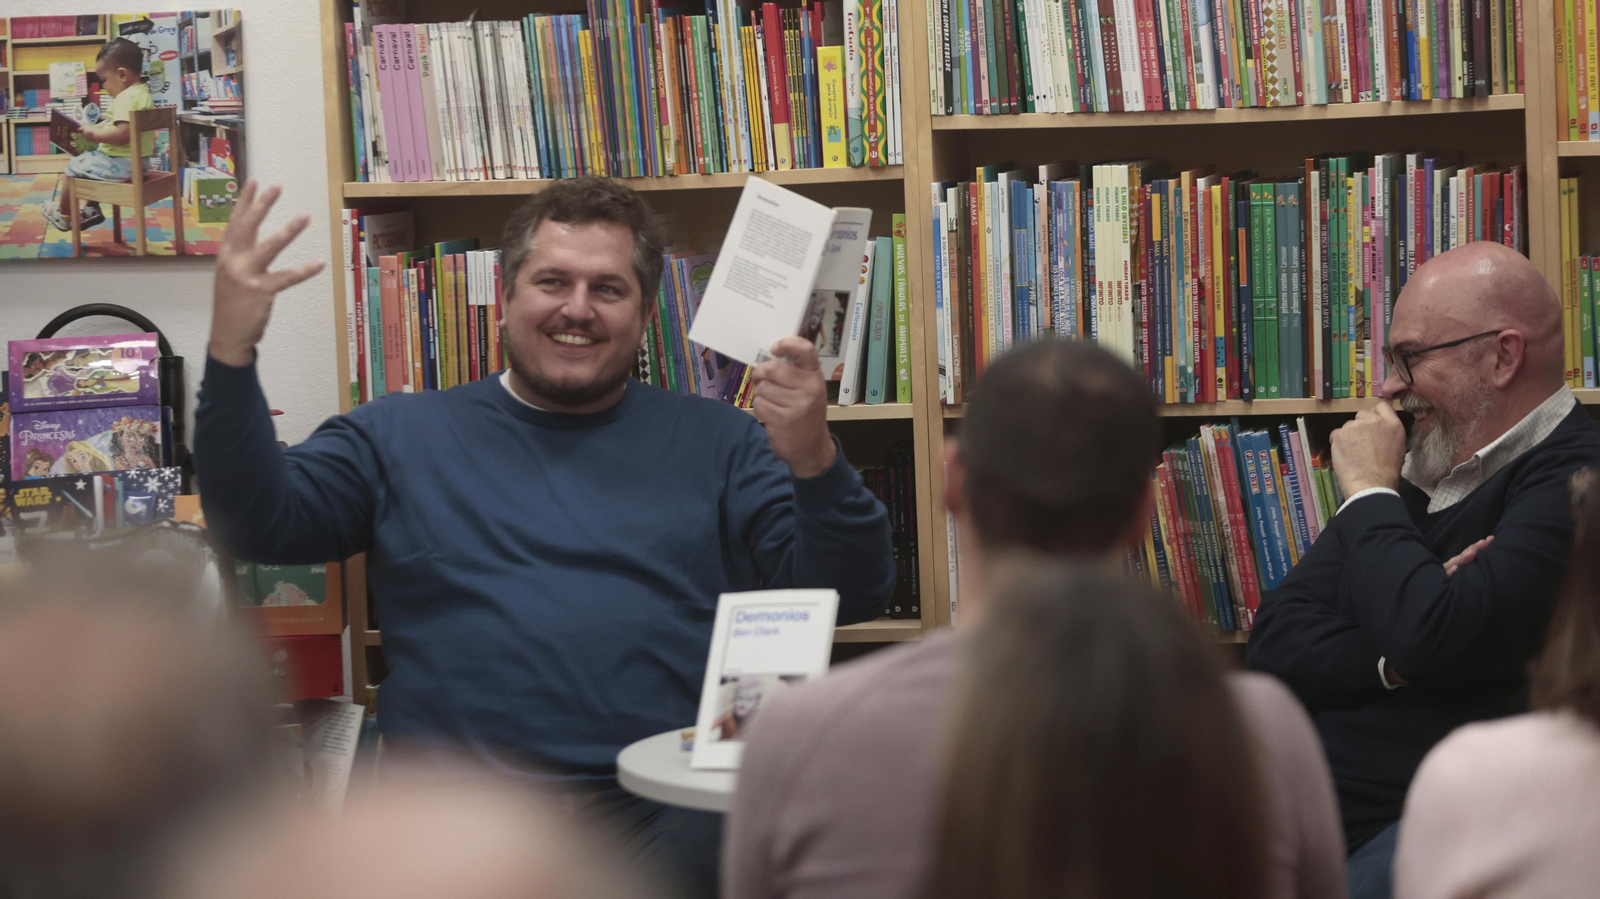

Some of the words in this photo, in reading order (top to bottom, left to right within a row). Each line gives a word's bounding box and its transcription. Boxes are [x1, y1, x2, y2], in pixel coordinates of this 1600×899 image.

[376, 31, 387, 70] Carnaval
[390, 31, 400, 70] Carnaval
[403, 31, 415, 70] Carnaval
[896, 244, 906, 275] NUEVAS
[900, 326, 908, 364] ANIMALES
[31, 420, 61, 431] Disney
[14, 495, 52, 507] WARS
[18, 486, 52, 496] STAR
[735, 609, 810, 623] Demonios
